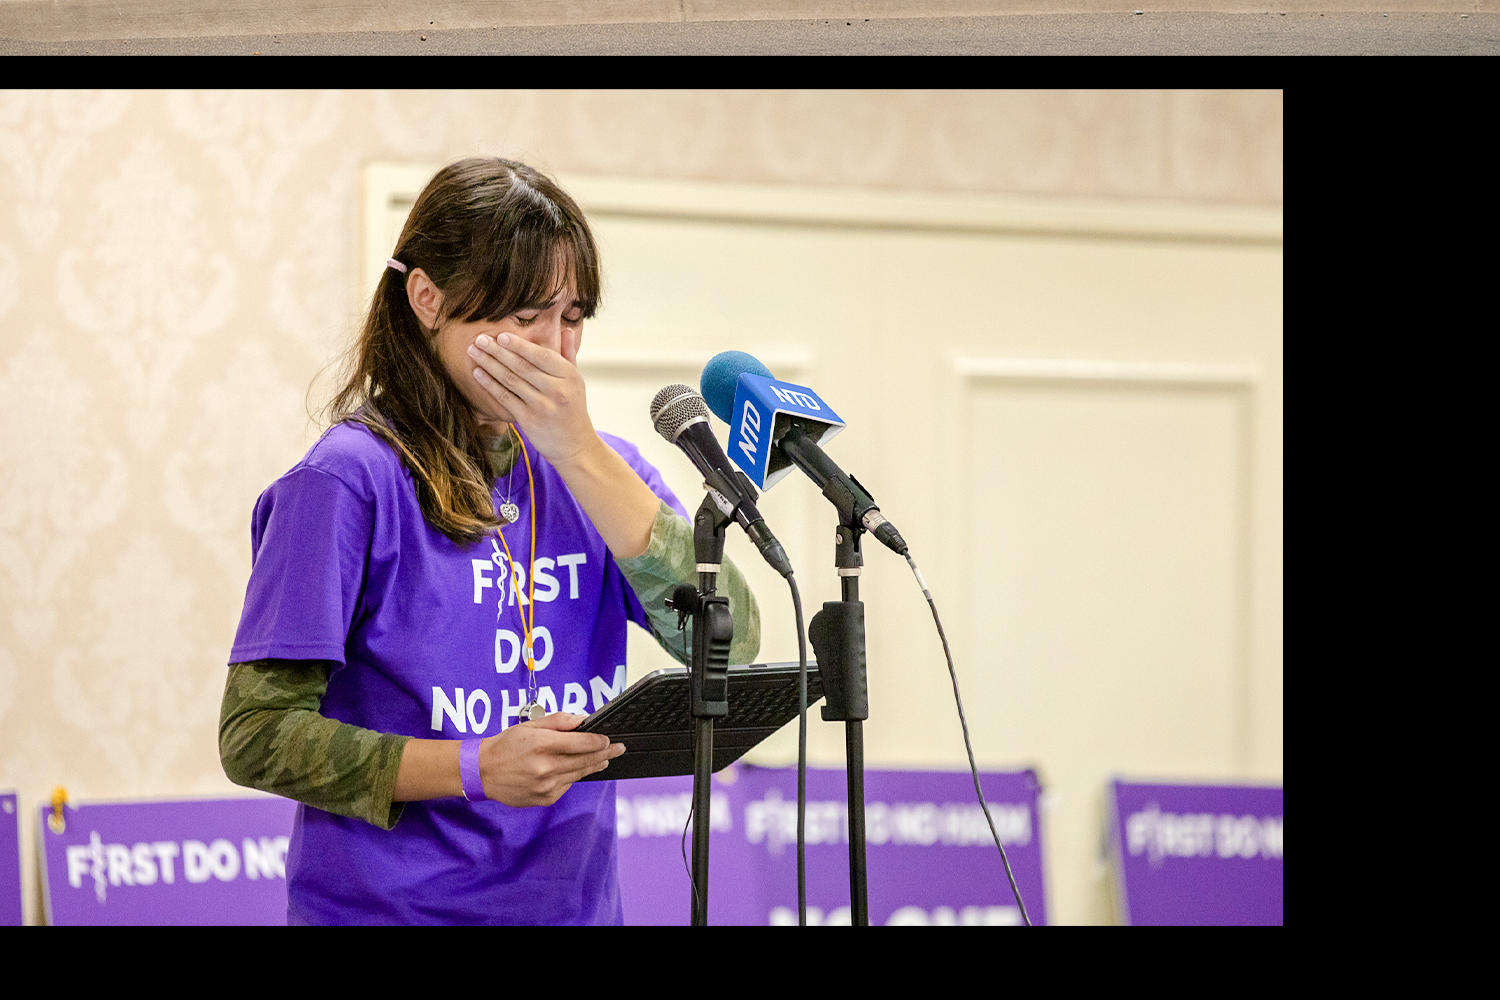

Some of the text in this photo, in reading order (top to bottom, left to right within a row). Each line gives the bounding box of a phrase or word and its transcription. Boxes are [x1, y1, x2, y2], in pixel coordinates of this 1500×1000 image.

[770, 385, 821, 411] NTD
[738, 400, 761, 465] NTD
[495, 626, 554, 674] DO
[431, 686, 491, 734] NO
[182, 837, 241, 883] DO
